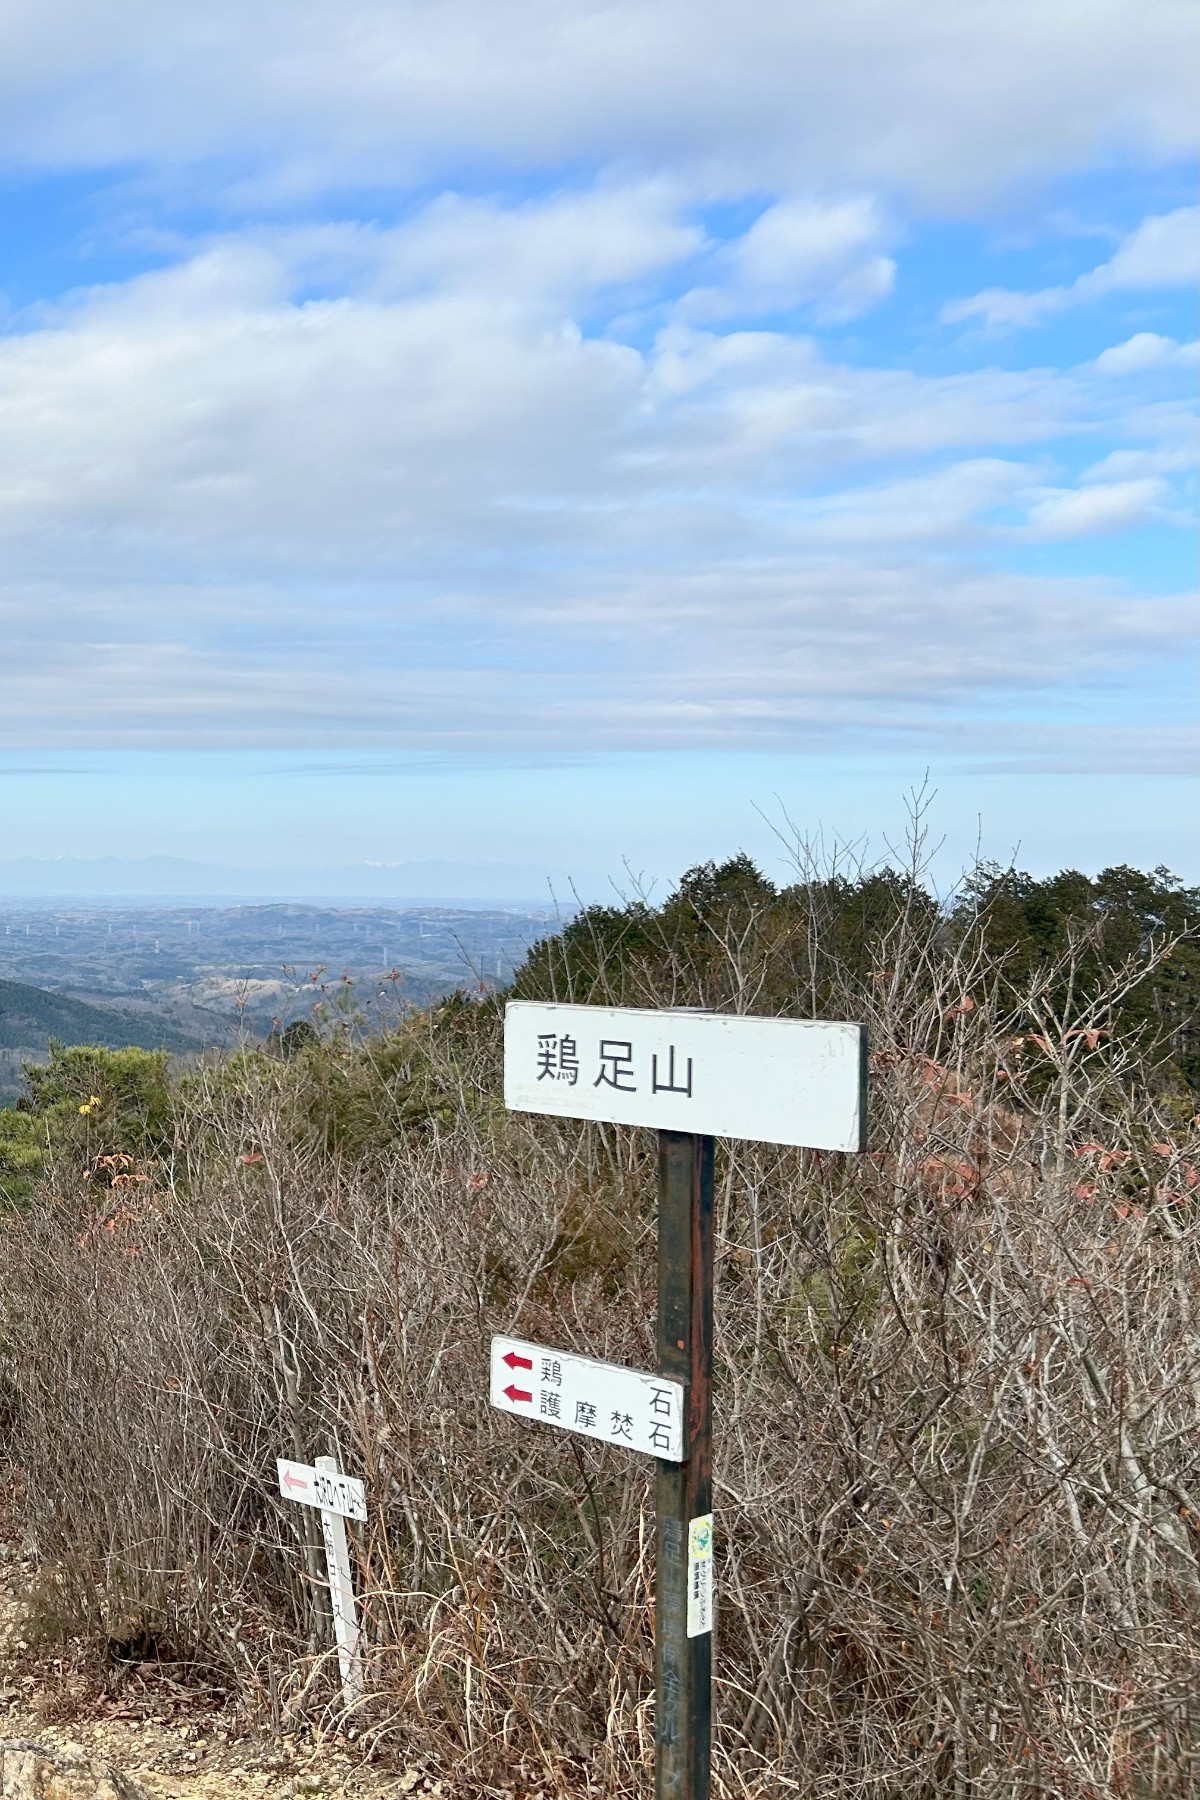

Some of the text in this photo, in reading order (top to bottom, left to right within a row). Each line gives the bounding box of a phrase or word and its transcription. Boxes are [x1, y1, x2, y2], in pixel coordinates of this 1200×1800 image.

[536, 1033, 694, 1099] 鶏足山
[539, 1388, 672, 1452] 護摩焚石
